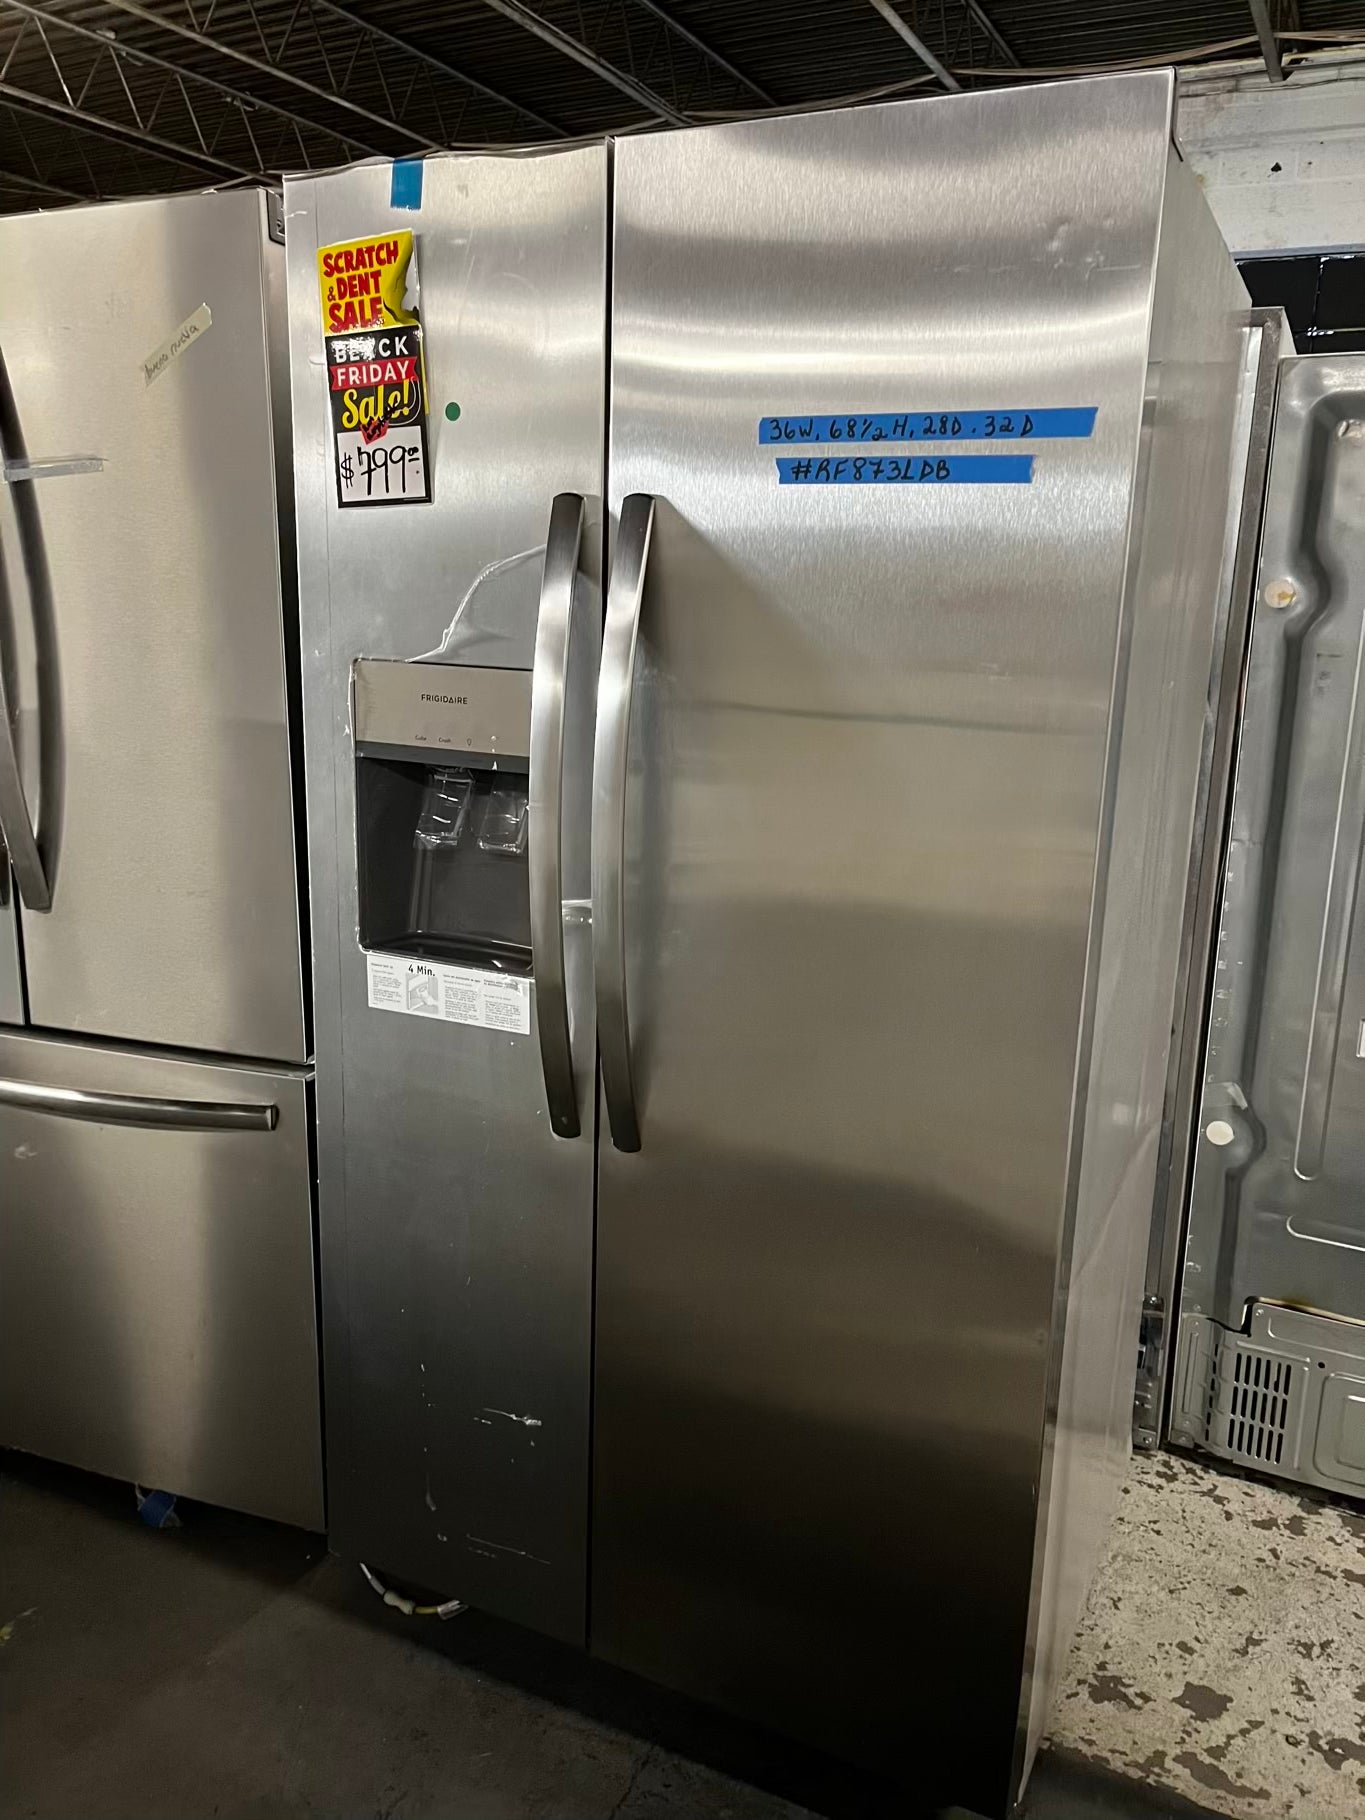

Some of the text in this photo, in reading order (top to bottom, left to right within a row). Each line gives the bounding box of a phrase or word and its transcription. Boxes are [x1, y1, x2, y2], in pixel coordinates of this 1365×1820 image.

[323, 240, 399, 278] SCRATCH
[327, 269, 382, 302] & DENT
[328, 297, 383, 333] SALE
[336, 359, 411, 387] FRIDAY
[342, 377, 411, 430] Sale!
[420, 693, 469, 706] FRIGIDAIRE
[408, 963, 436, 976] 4 Min.
